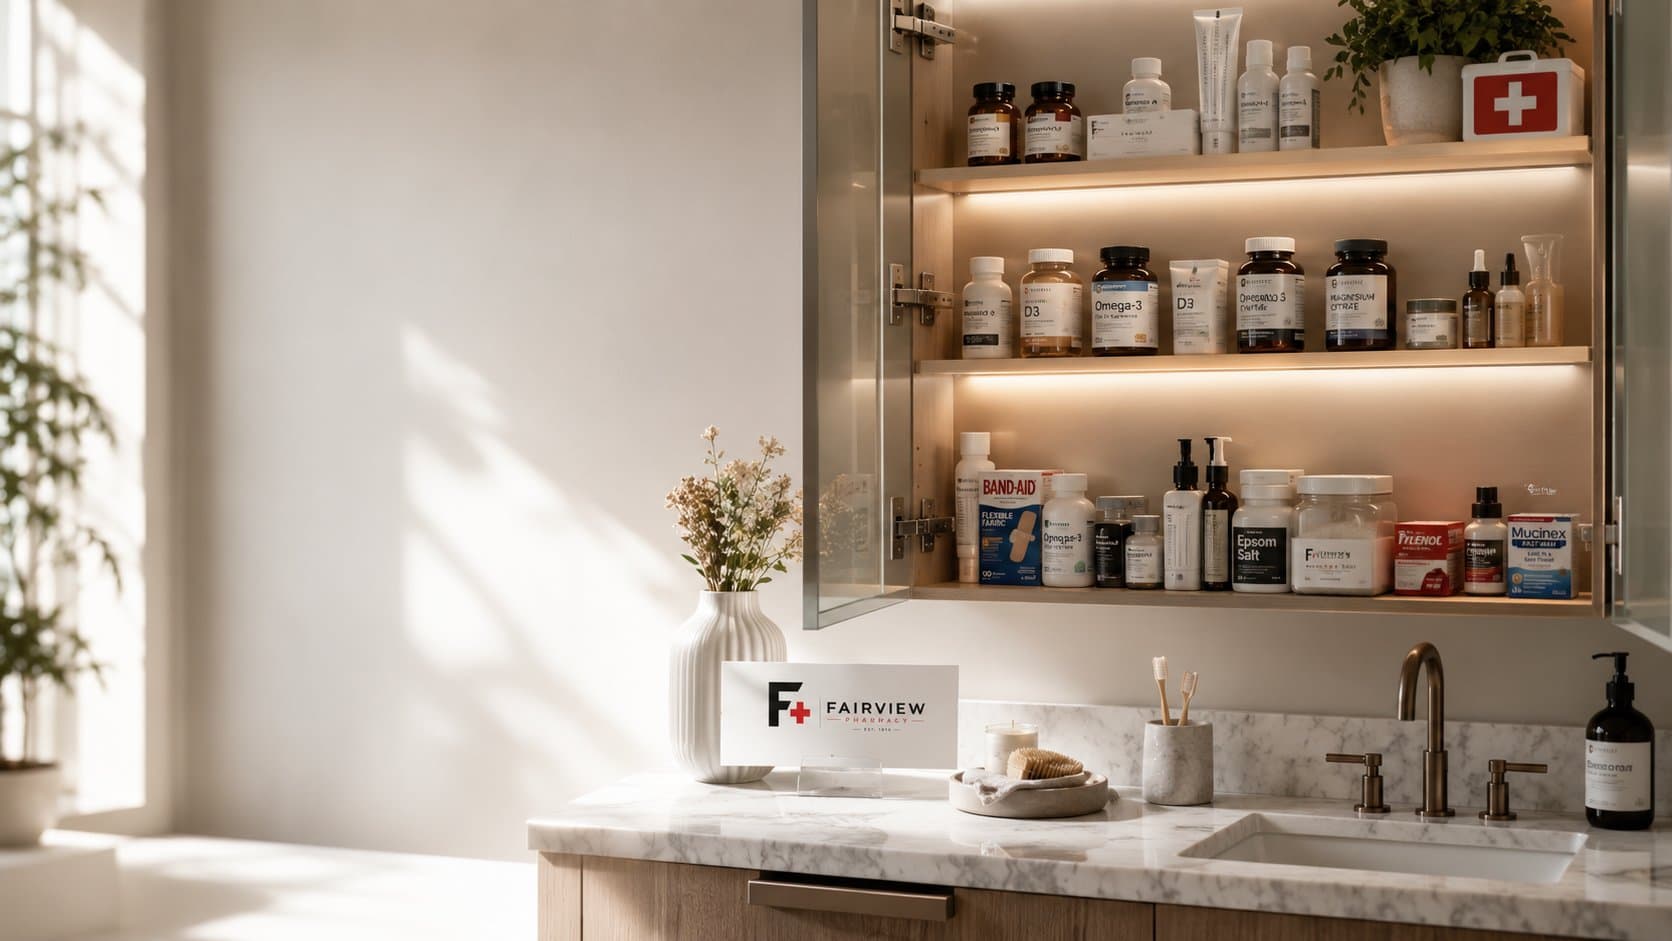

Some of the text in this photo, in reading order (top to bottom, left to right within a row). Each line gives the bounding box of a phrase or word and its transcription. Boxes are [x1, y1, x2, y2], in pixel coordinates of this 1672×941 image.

[1095, 300, 1143, 312] Omega-3
[1177, 297, 1194, 309] D3
[1024, 306, 1040, 317] D3
[983, 479, 1036, 495] BAND-AID
[1511, 527, 1566, 539] Mucinex
[1237, 534, 1277, 549] Epsom
[1237, 549, 1260, 561] Salt
[826, 702, 926, 715] FAIRVIEW
